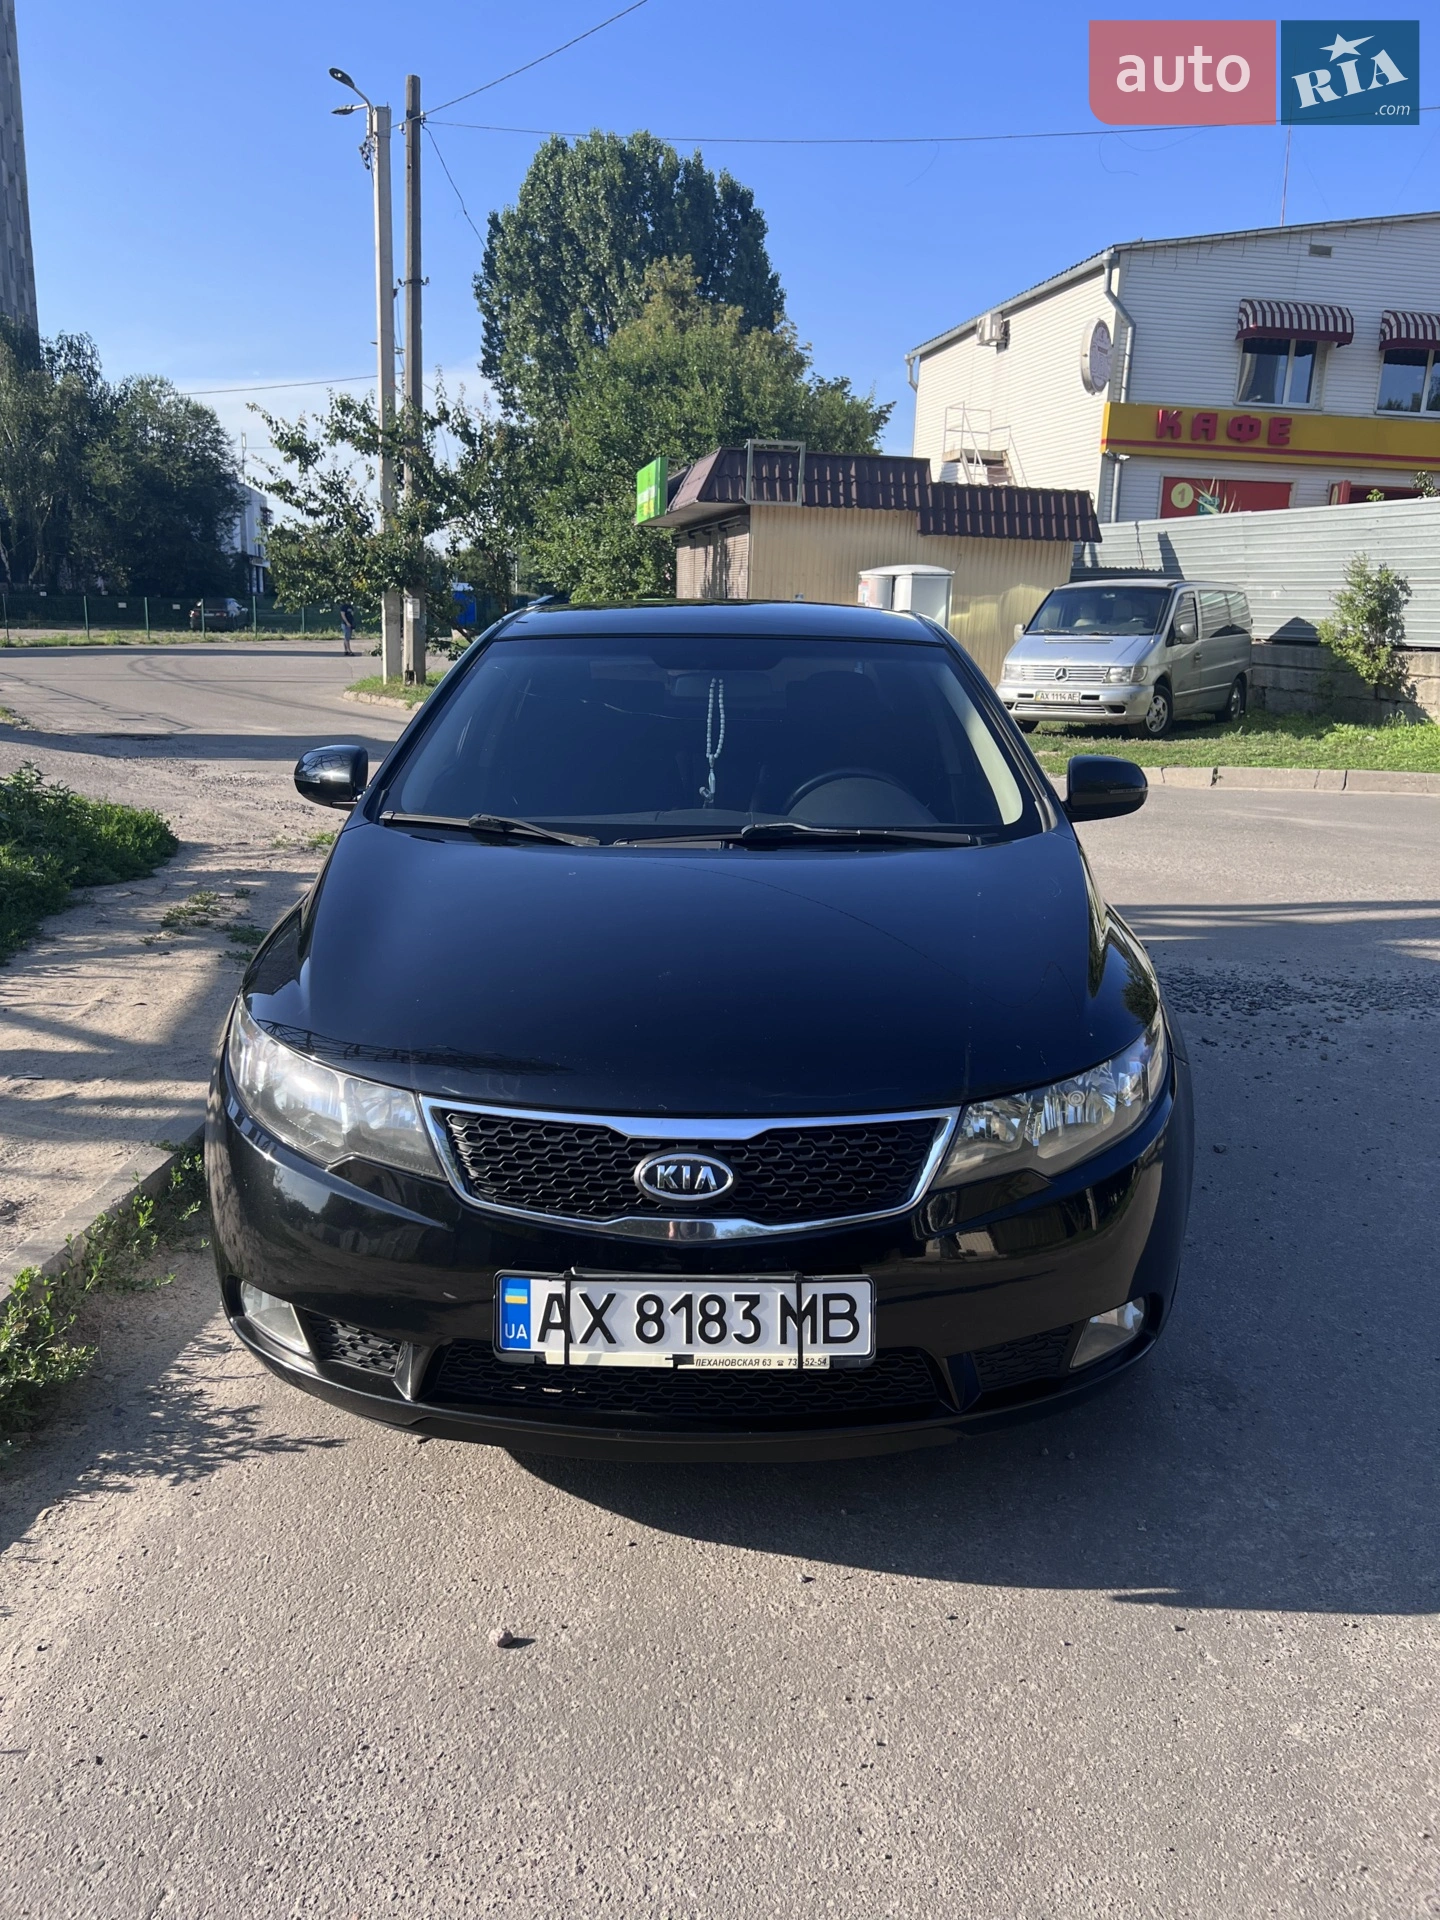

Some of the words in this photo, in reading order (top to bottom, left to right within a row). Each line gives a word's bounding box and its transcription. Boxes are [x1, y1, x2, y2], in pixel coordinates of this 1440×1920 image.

[1156, 409, 1292, 446] КАФЕ
[656, 1164, 718, 1191] KIA
[505, 1323, 528, 1340] UA
[537, 1292, 617, 1344] AX
[634, 1292, 761, 1345] 8183
[779, 1292, 860, 1344] MB
[762, 1358, 772, 1367] 63
